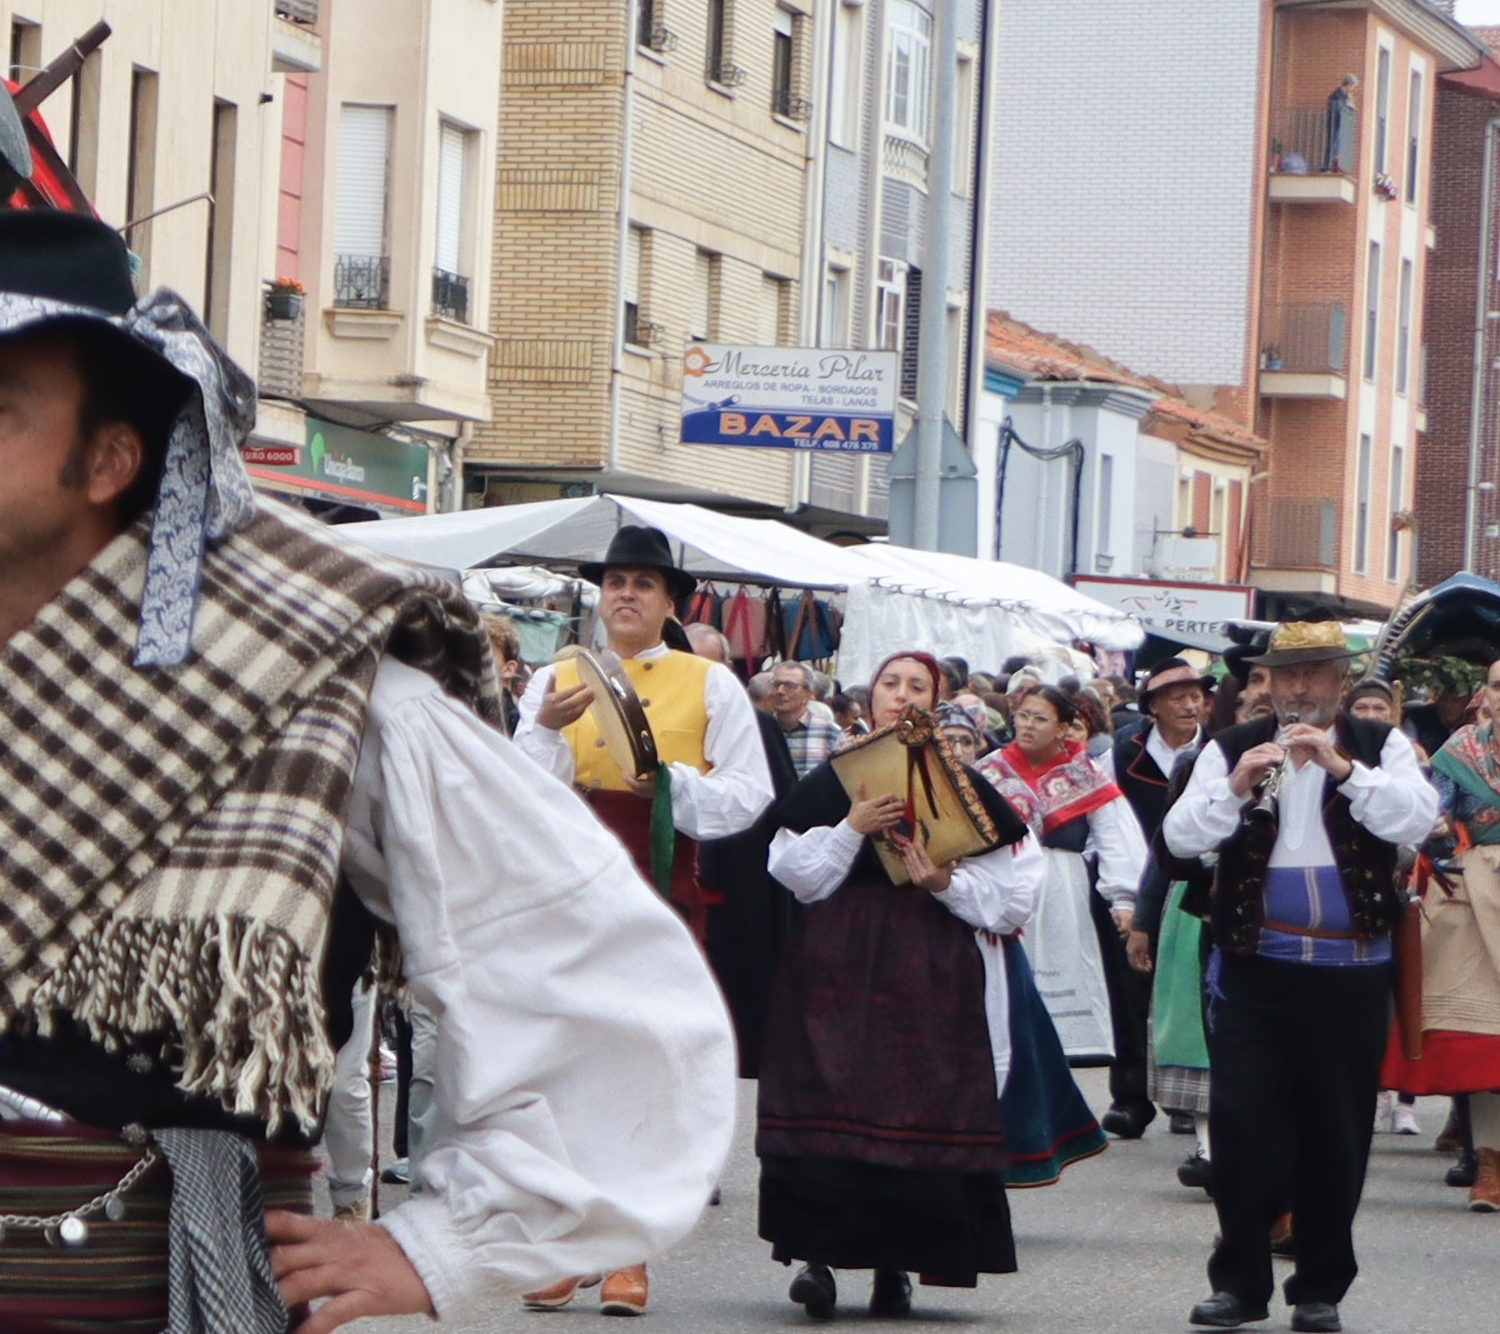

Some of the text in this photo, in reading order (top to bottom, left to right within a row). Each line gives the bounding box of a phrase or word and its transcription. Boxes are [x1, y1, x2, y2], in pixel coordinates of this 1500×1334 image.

[817, 354, 884, 381] Pilar
[703, 380, 761, 391] ARREGLOS
[763, 381, 778, 392] DE
[781, 382, 810, 393] ROPA
[818, 385, 879, 396] BORDADOS
[801, 395, 834, 406] TELAS
[843, 397, 878, 407] LANAS
[718, 412, 881, 442] BAZAR
[241, 450, 265, 461] URO
[1165, 618, 1219, 633] PERTE
